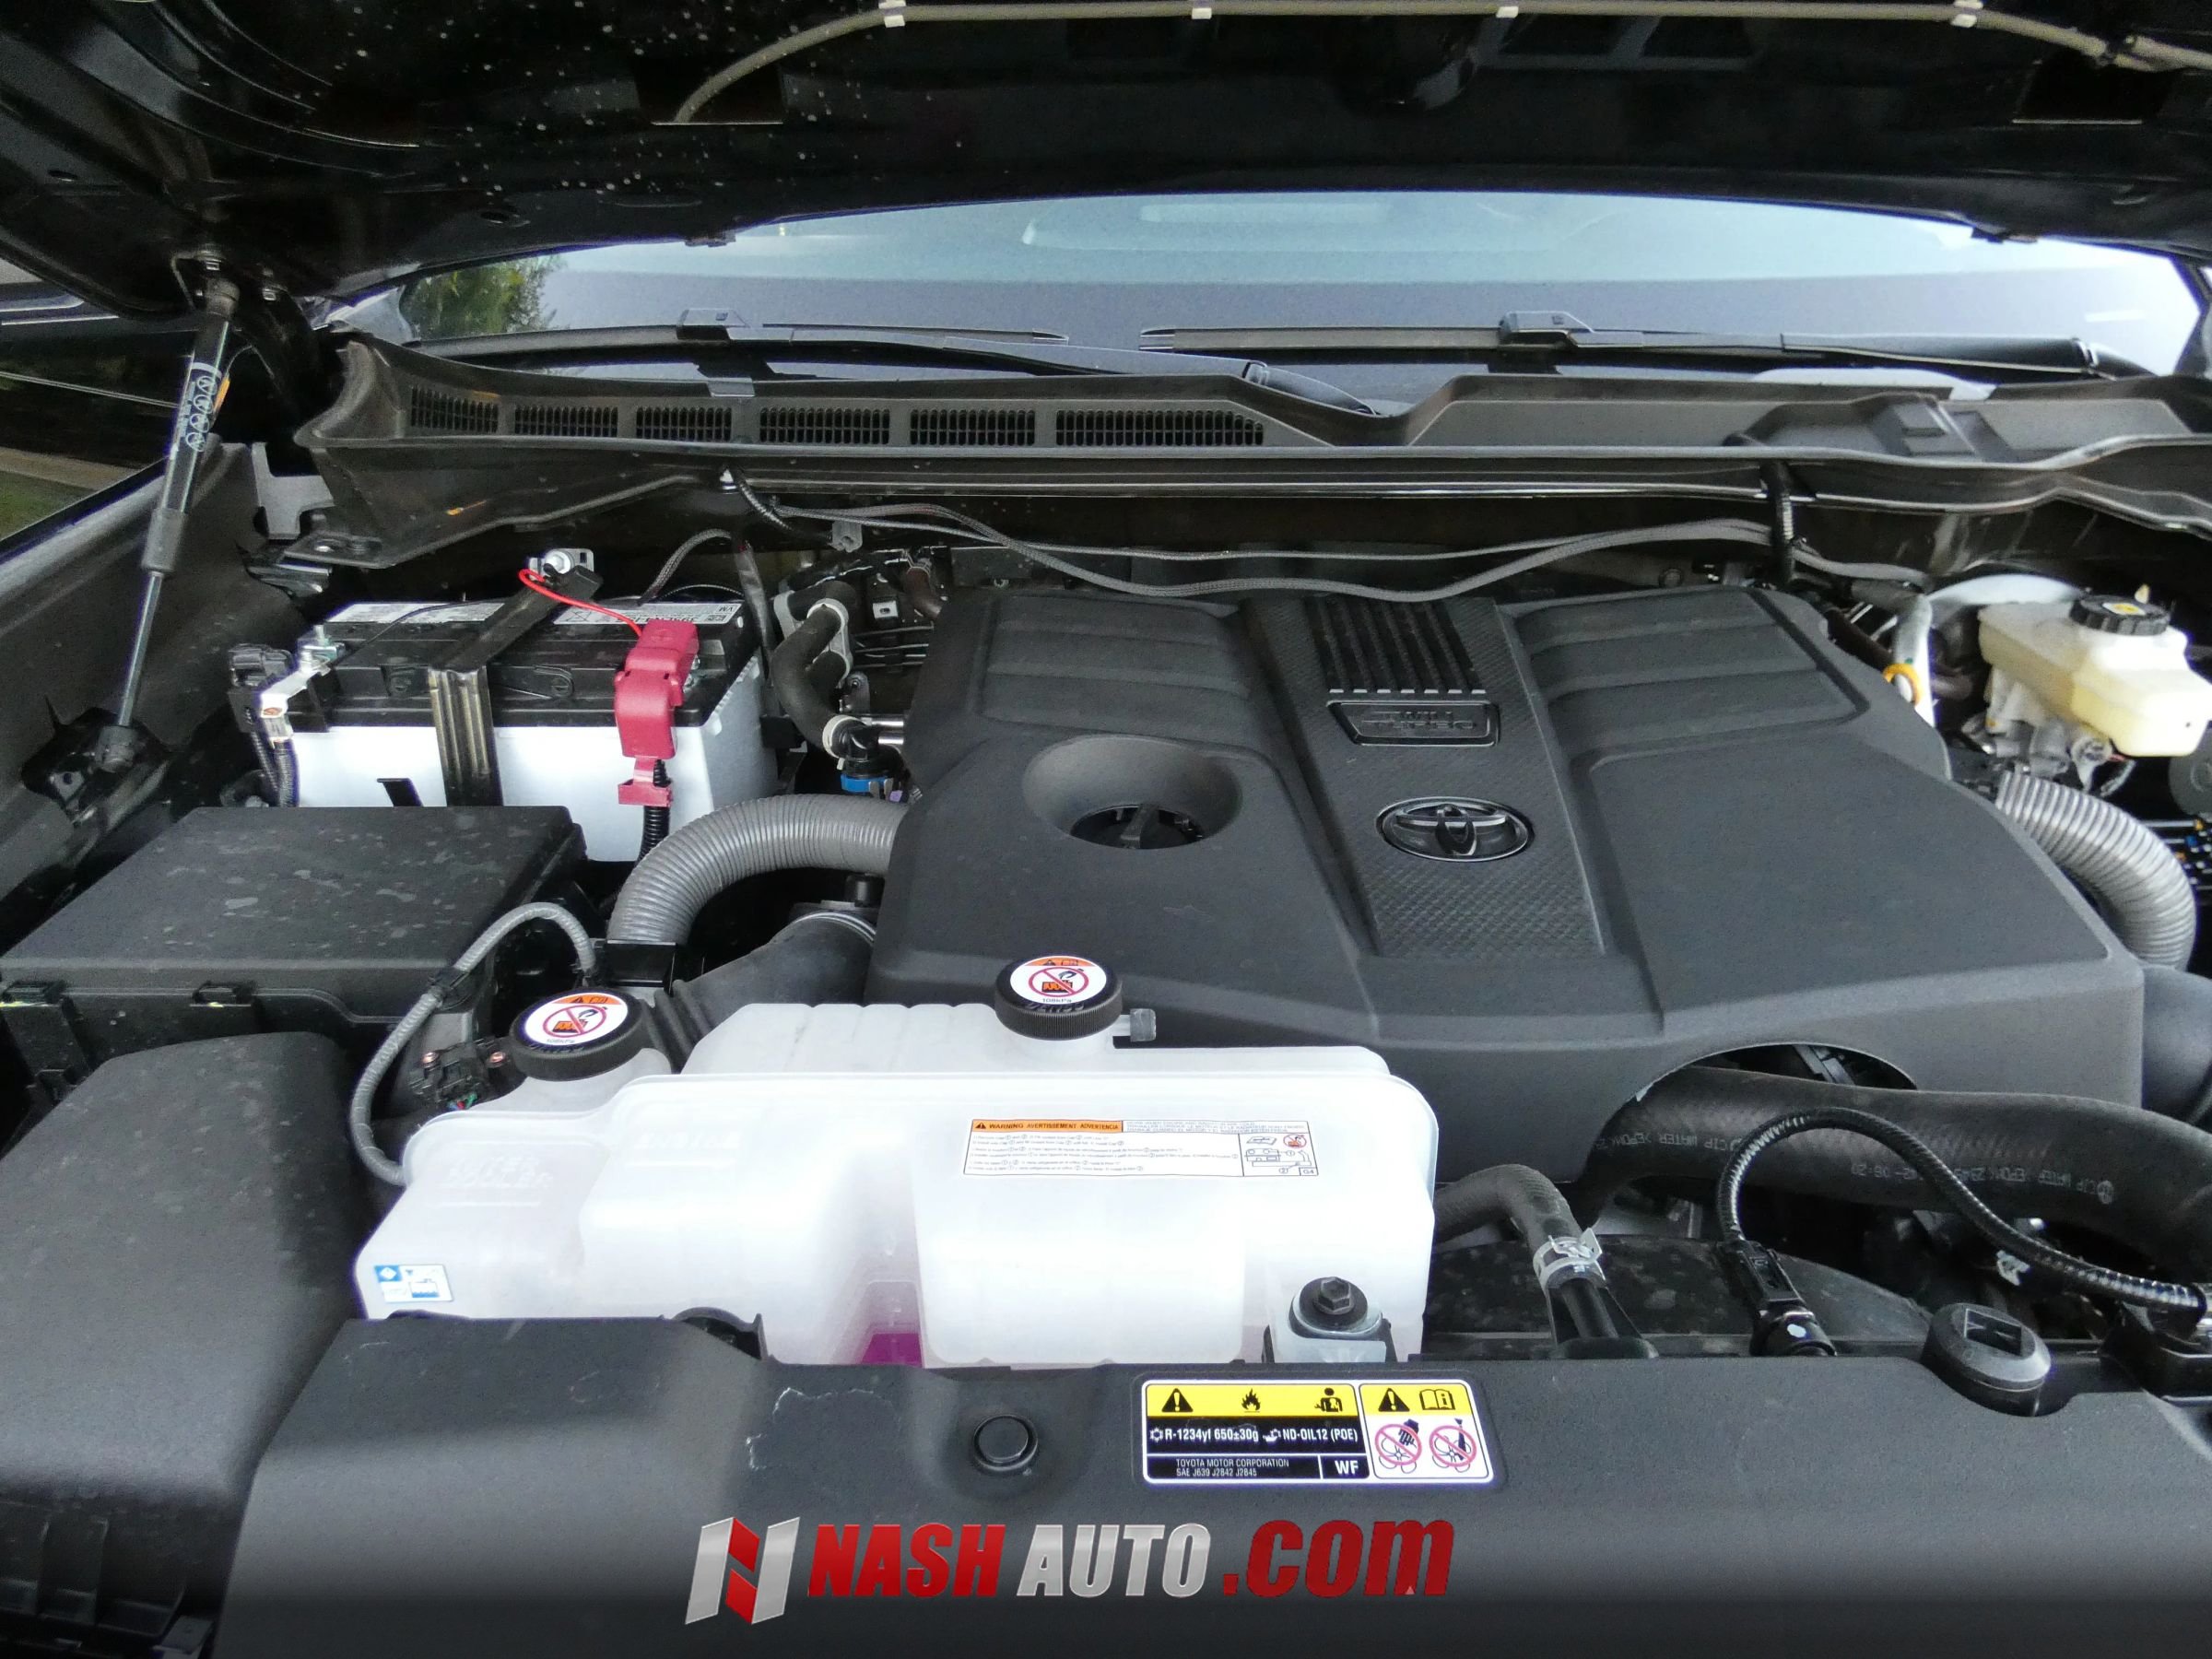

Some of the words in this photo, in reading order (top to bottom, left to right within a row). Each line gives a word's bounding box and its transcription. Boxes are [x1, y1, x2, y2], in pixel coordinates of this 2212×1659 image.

[1165, 1429, 1211, 1443] R-1234yf
[1214, 1428, 1258, 1441] 650±30g
[1283, 1429, 1328, 1441] ND-OIL12
[1331, 1428, 1358, 1442] (POE)
[1176, 1458, 1205, 1466] TOYOTA
[1206, 1458, 1234, 1466] MOTOR
[1236, 1458, 1289, 1467] CORPORATION
[1334, 1460, 1359, 1475] WF
[1176, 1468, 1190, 1477] SAE
[1192, 1468, 1210, 1477] J639
